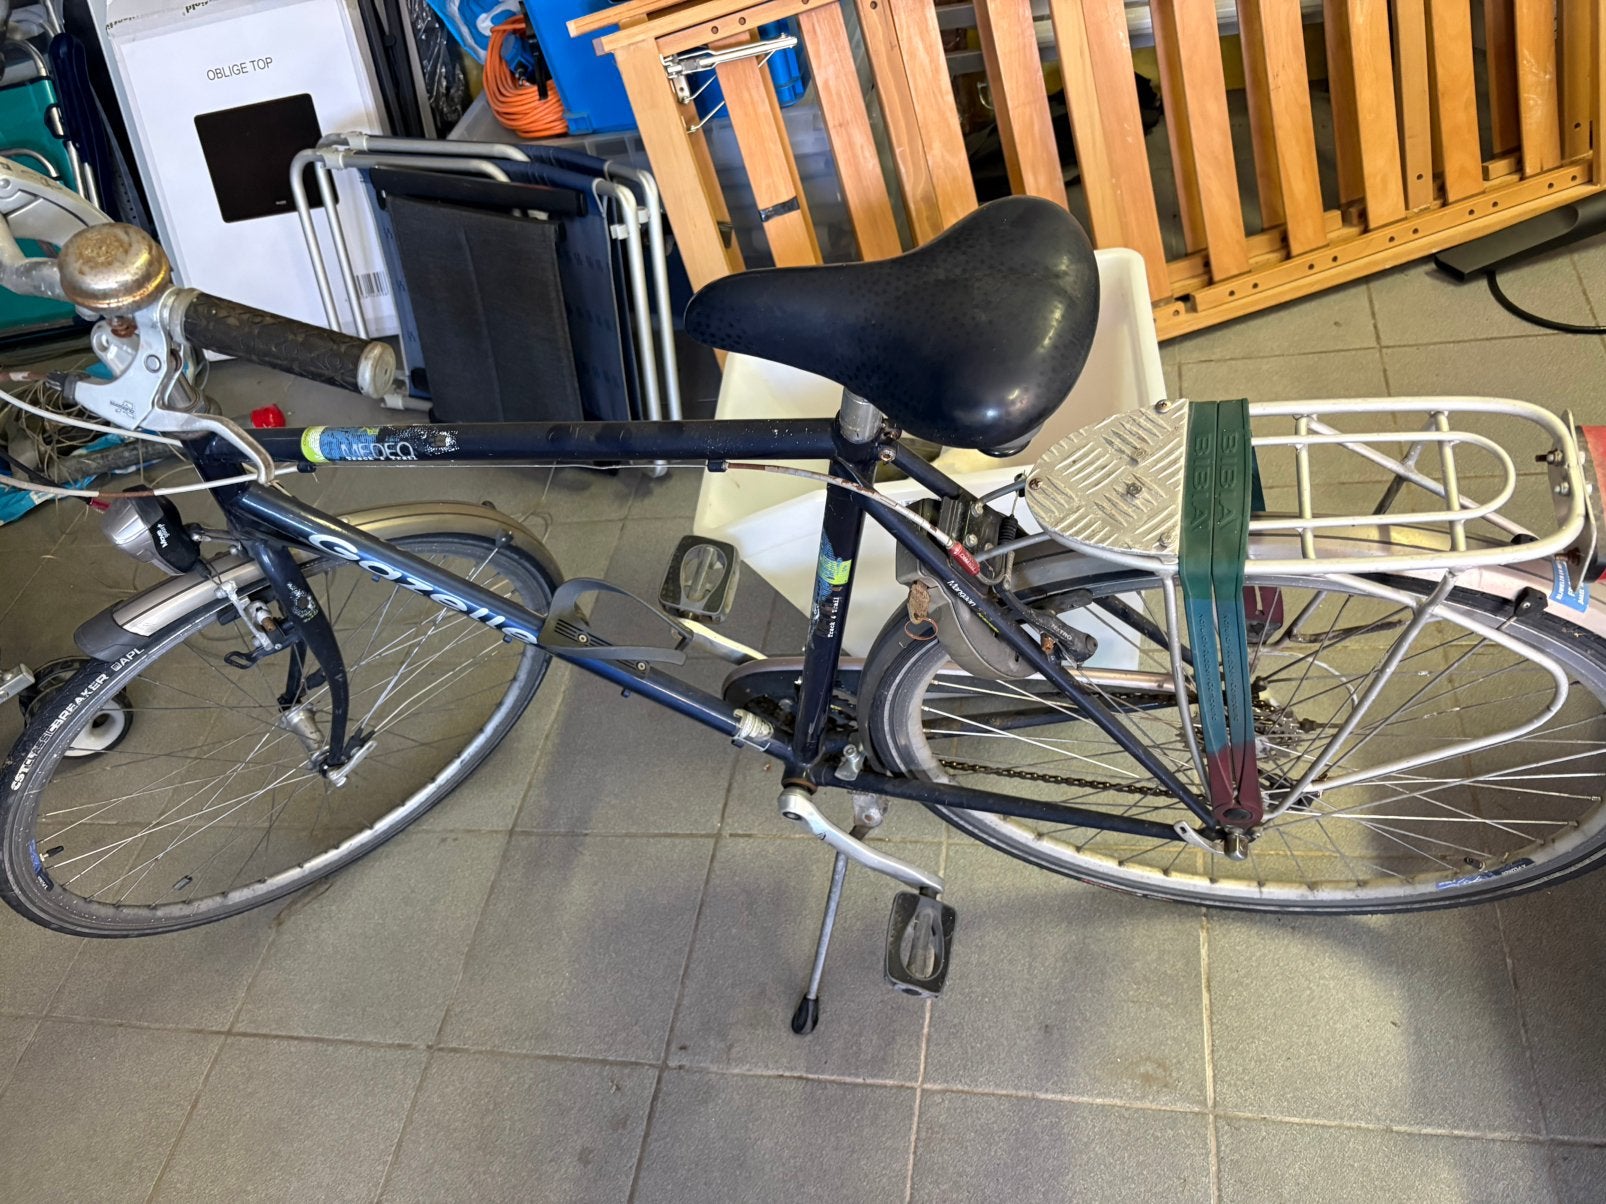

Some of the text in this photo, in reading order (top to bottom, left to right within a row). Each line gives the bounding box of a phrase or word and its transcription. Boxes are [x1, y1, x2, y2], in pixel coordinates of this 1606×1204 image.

[206, 56, 273, 81] OBLIGE TOP
[341, 441, 416, 460] MEDEQ
[1217, 430, 1239, 530] BIBA
[1190, 433, 1213, 532] BIBA
[308, 533, 538, 645] Gazelle
[118, 648, 145, 667] APL
